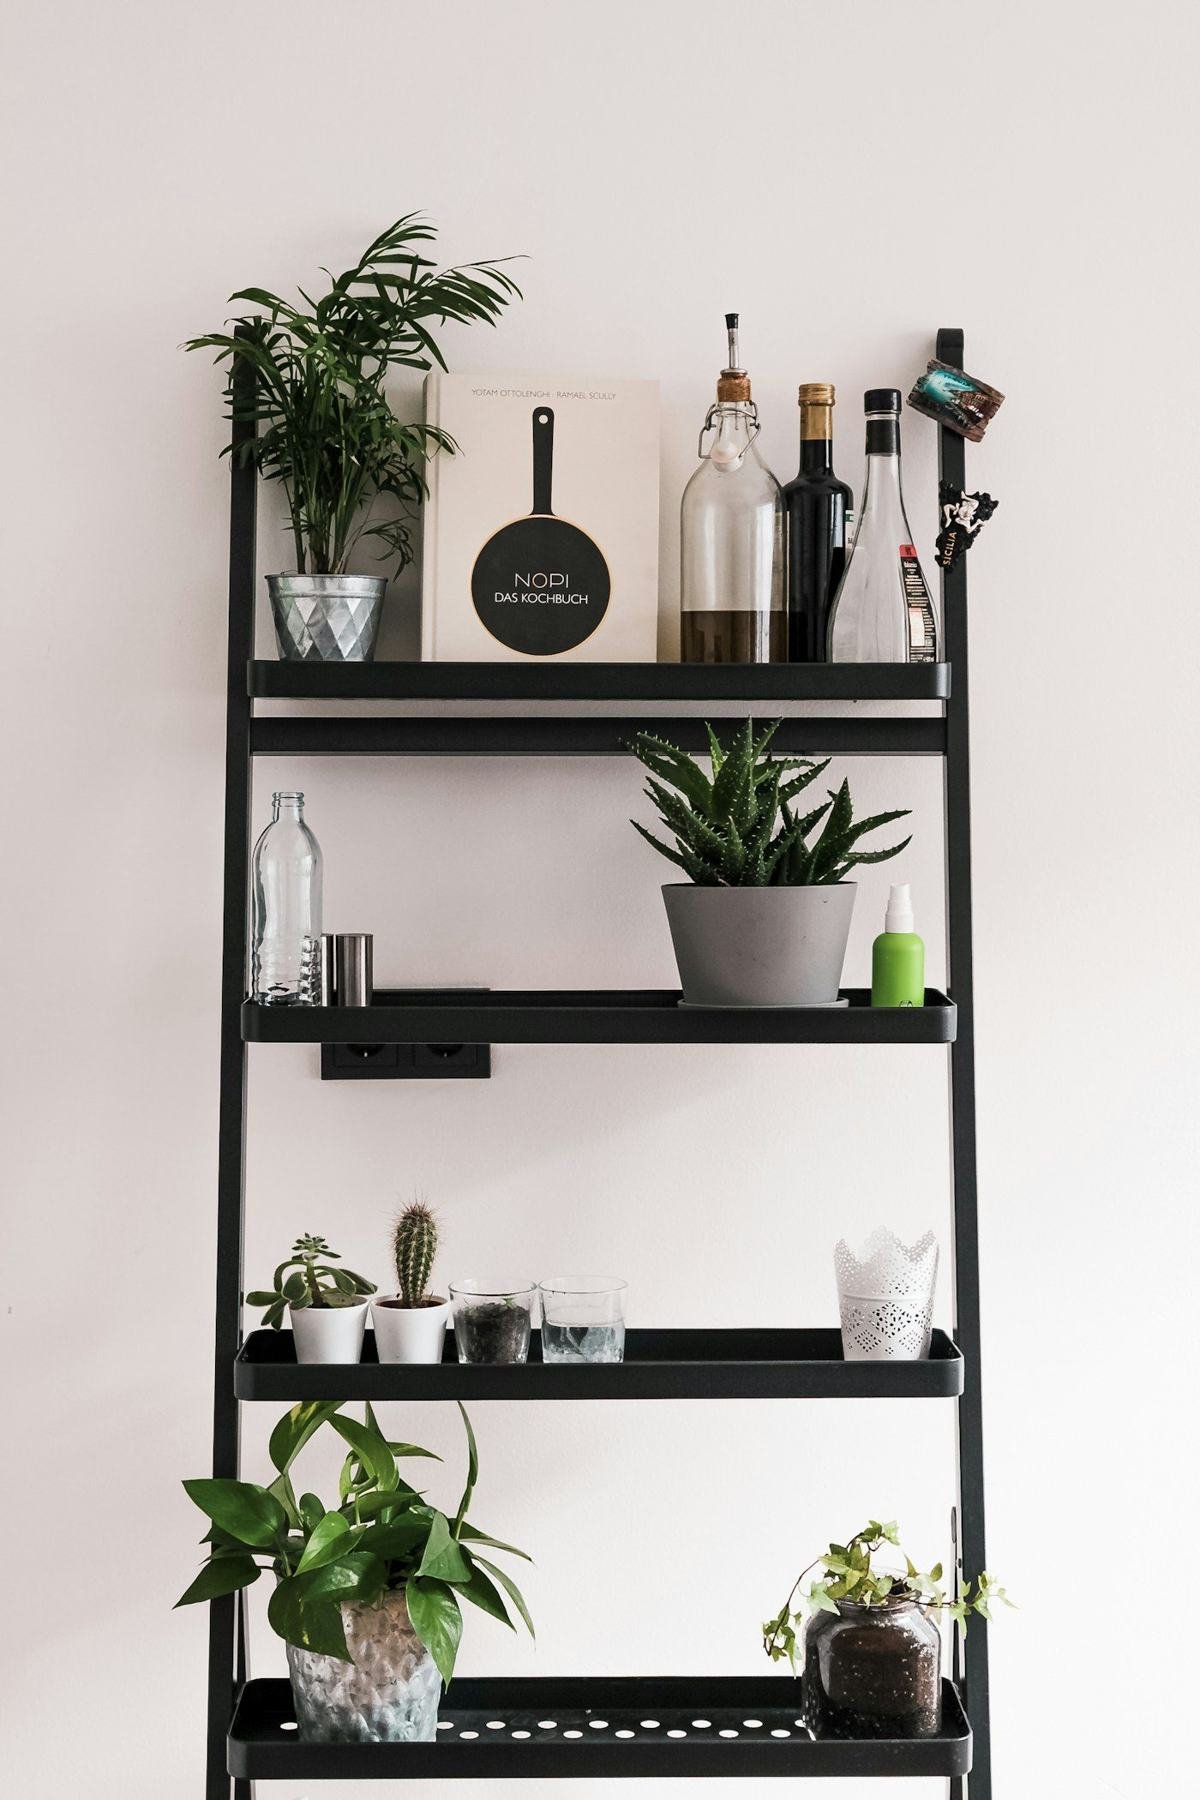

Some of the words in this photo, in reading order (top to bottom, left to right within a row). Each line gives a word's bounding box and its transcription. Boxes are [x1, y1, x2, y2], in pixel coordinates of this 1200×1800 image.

[471, 388, 498, 397] YOTAM
[499, 389, 551, 398] OTTOLENGHI
[556, 391, 586, 400] RAMAEL
[588, 391, 617, 401] SCULLY
[943, 531, 957, 566] SICILIA
[514, 572, 569, 588] NOPI
[494, 592, 519, 603] DAS
[521, 593, 589, 605] KOCHBUCH
